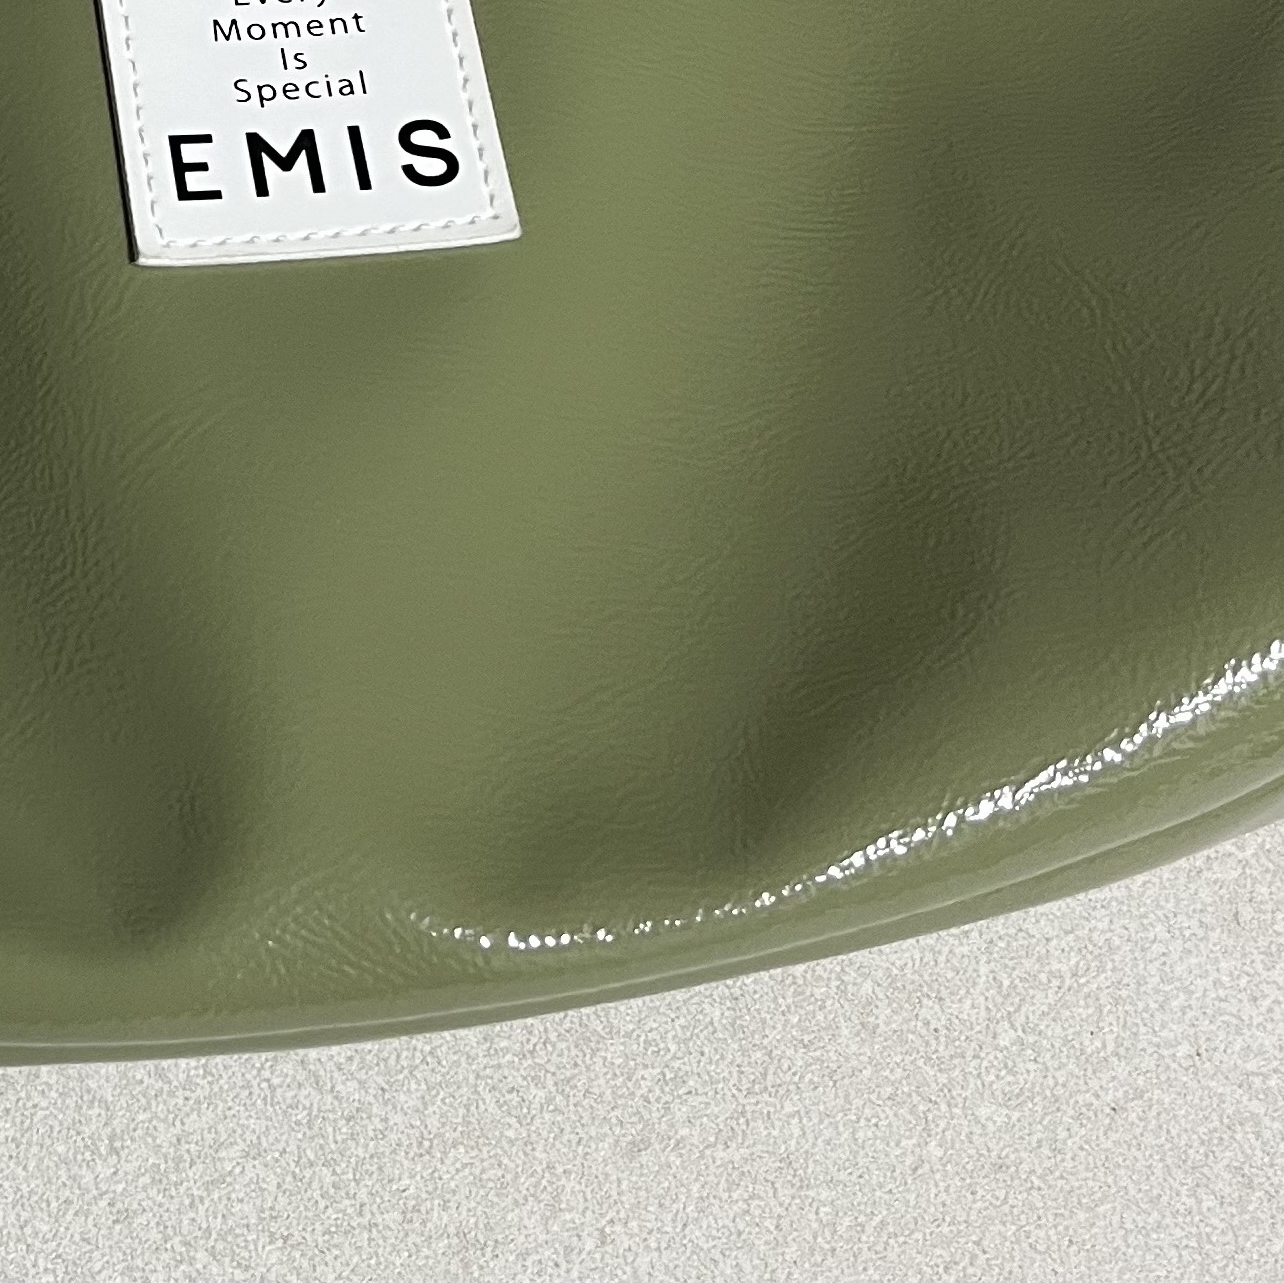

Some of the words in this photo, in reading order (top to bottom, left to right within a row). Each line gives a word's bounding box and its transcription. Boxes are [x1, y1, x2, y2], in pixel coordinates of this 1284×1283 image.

[213, 13, 365, 41] Moment
[281, 48, 307, 70] Is
[234, 70, 367, 108] Special
[168, 119, 459, 201] EMIS
